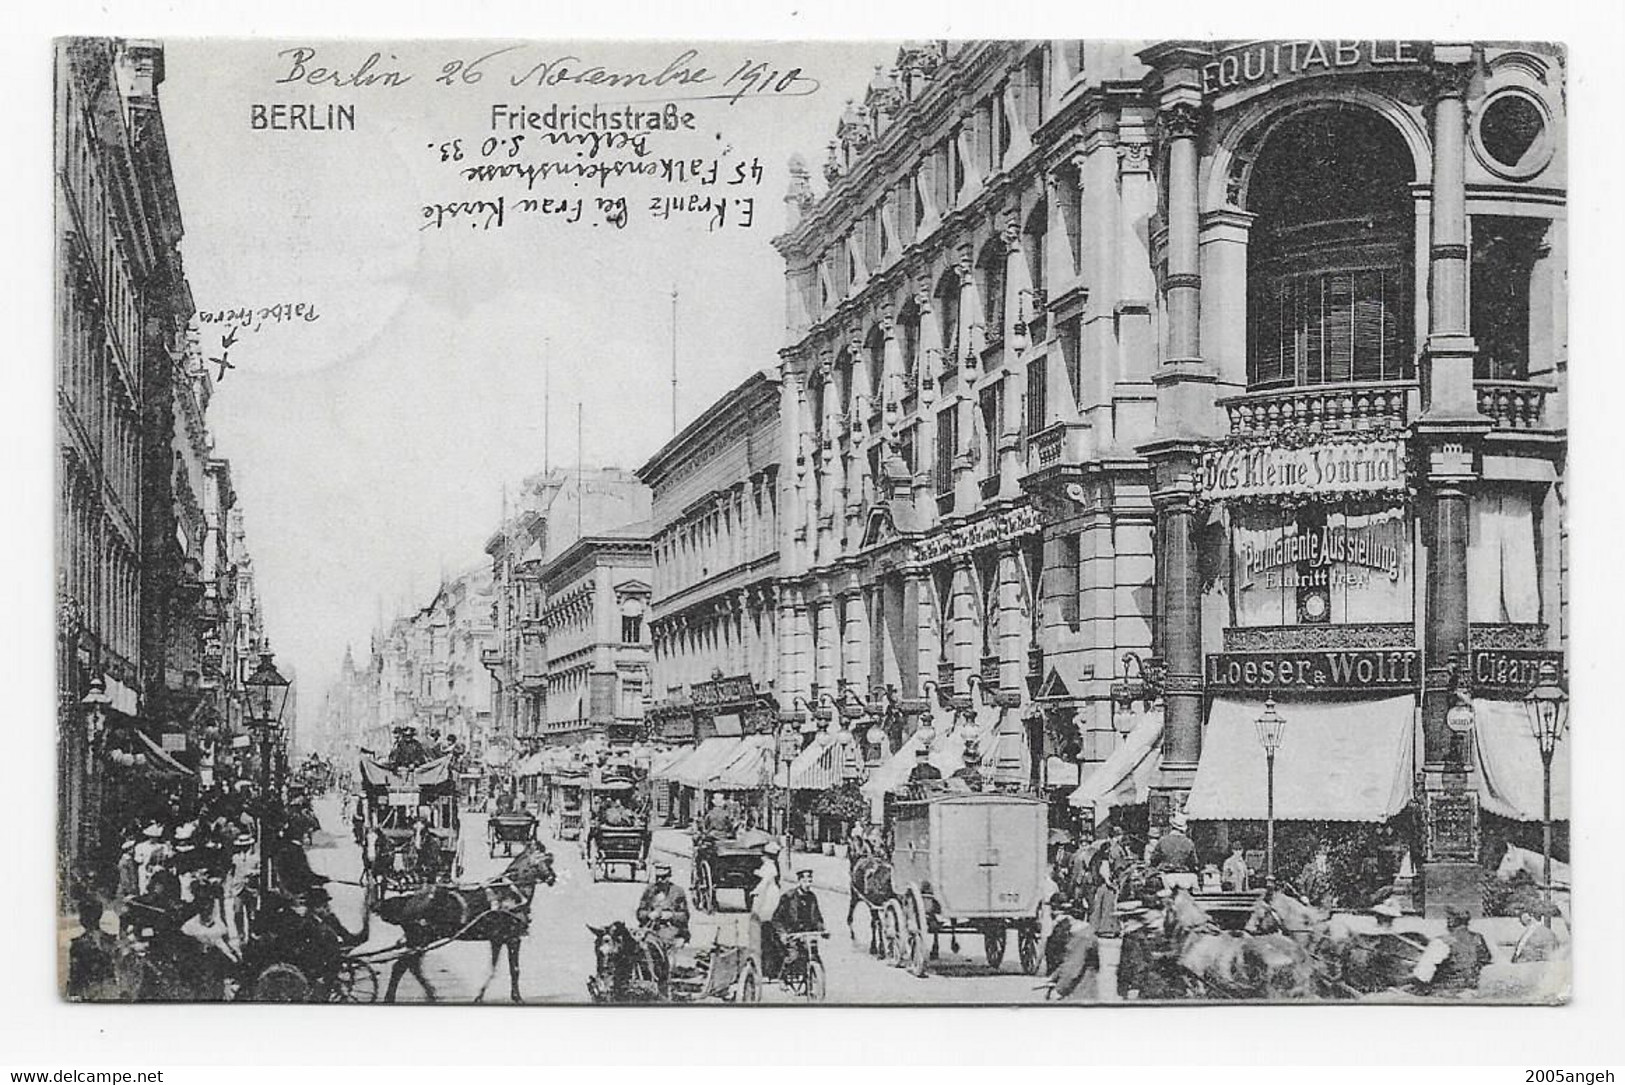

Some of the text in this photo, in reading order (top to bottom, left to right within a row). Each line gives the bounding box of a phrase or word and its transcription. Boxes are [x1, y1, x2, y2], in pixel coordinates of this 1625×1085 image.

[277, 47, 413, 87] Berlin
[436, 47, 526, 86] 26
[1203, 39, 1418, 94] EQUITABLE
[251, 105, 356, 131] BERLIN
[491, 103, 696, 131] Friedrichstraße
[540, 133, 652, 157] Berlin
[458, 158, 764, 191] 45 Falkensteinstrasse
[510, 198, 583, 225] Frau
[1202, 448, 1399, 491] Das Kleine Journal
[1243, 525, 1400, 582] Permanente Ausstellung
[1264, 568, 1328, 590] Eintritt
[1209, 652, 1416, 684] Loeser & Wolff
